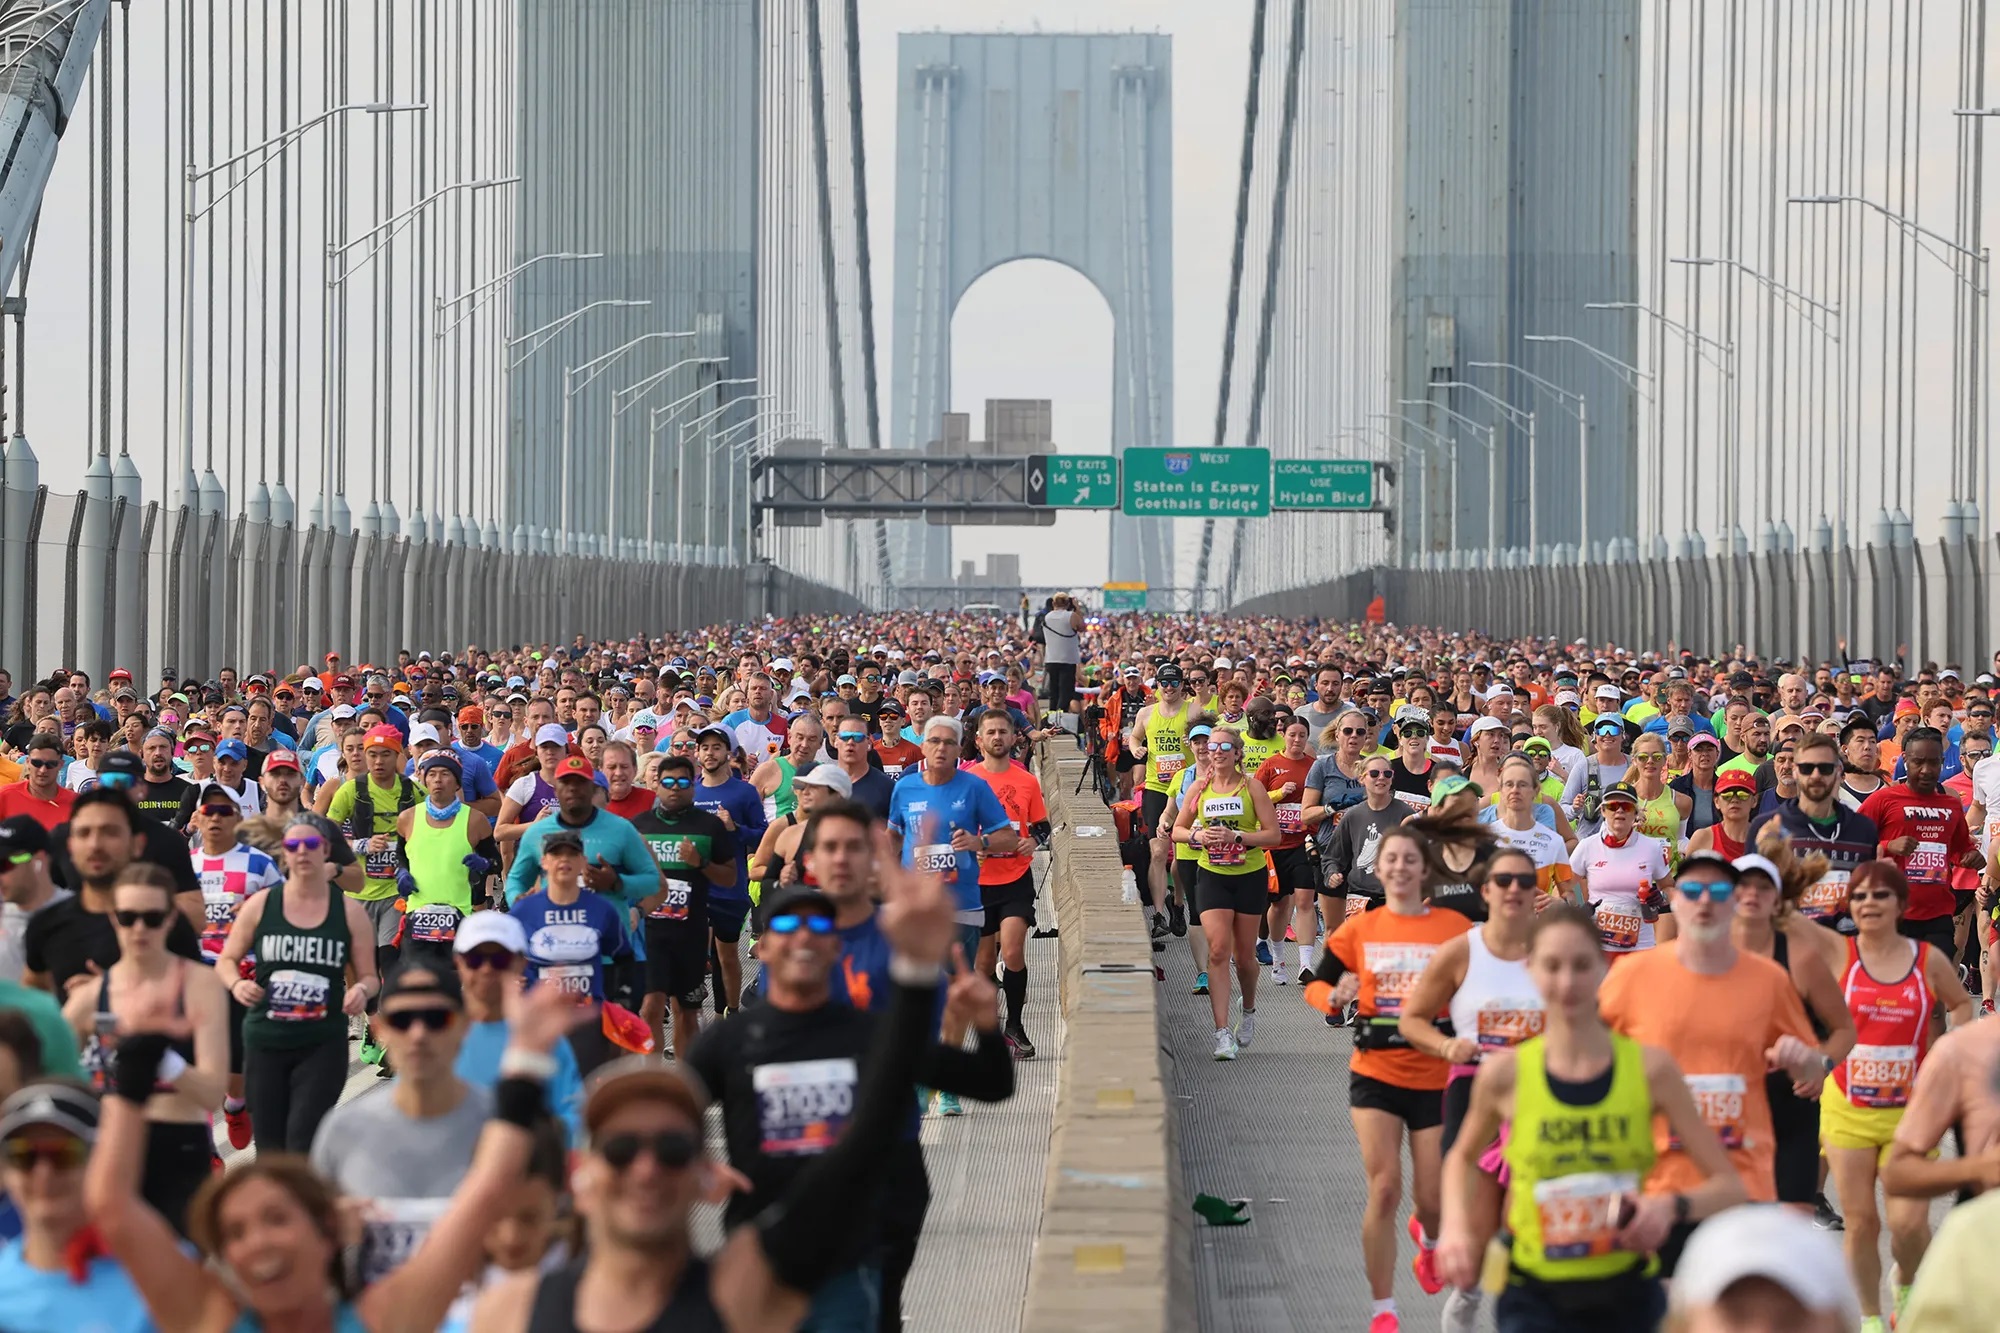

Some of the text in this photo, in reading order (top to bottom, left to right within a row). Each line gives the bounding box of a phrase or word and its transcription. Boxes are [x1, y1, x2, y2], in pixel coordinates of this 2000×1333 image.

[1059, 460, 1107, 470] TO EXITS
[1169, 459, 1188, 470] 278
[1200, 453, 1230, 463] WEST
[1278, 464, 1367, 474] LOCAL STREETS
[1053, 473, 1111, 485] 14 TO 13
[1310, 478, 1331, 488] USE
[1134, 481, 1259, 495] Staten Is Expwy
[1280, 490, 1366, 505] Hylan Blvd
[1135, 498, 1258, 512] Goethals Bridge
[1154, 736, 1181, 744] TEAM
[1160, 760, 1182, 771] 6623
[1206, 803, 1241, 812] KRISTEN
[1904, 806, 1953, 821] FDNY
[1205, 820, 1239, 830] TAM
[648, 840, 696, 853] EGA
[369, 851, 399, 865] 3146
[657, 852, 685, 862] NNE
[1909, 852, 1946, 868] 26155
[414, 913, 455, 927] 23260
[545, 909, 588, 925] ELLIE
[1598, 913, 1640, 932] 34458
[261, 934, 345, 968] MICHELLE
[272, 982, 325, 1002] 27423
[1853, 1060, 1912, 1082] 29847
[1538, 1114, 1631, 1143] ASHLEY
